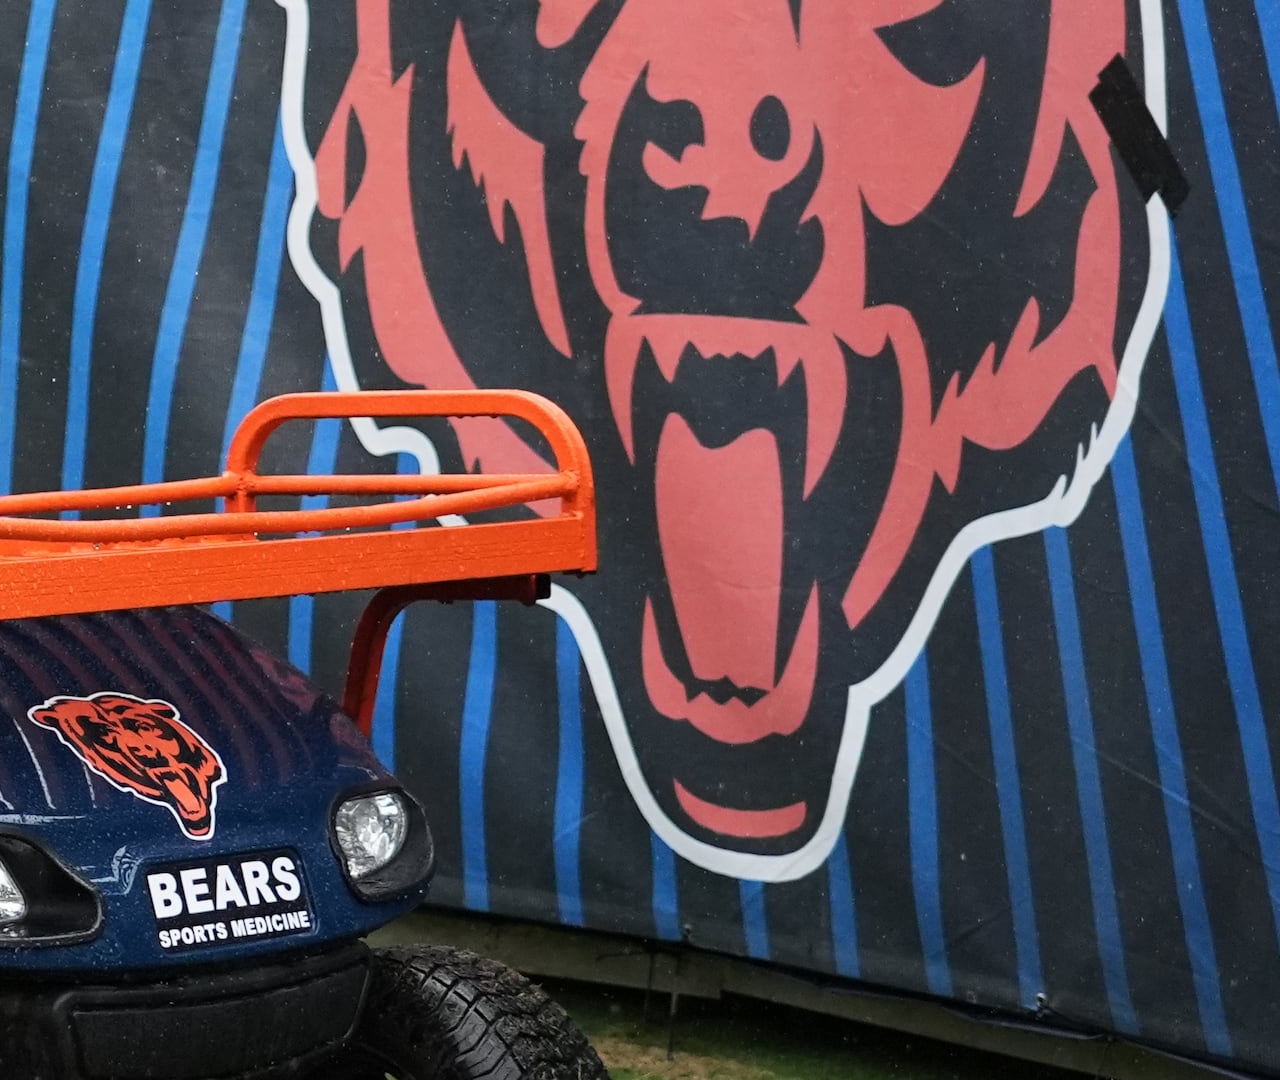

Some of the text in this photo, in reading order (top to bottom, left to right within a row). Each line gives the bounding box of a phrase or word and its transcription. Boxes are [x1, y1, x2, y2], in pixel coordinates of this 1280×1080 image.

[146, 856, 302, 919] BEARS
[158, 910, 311, 948] SPORTS MEDICINE
